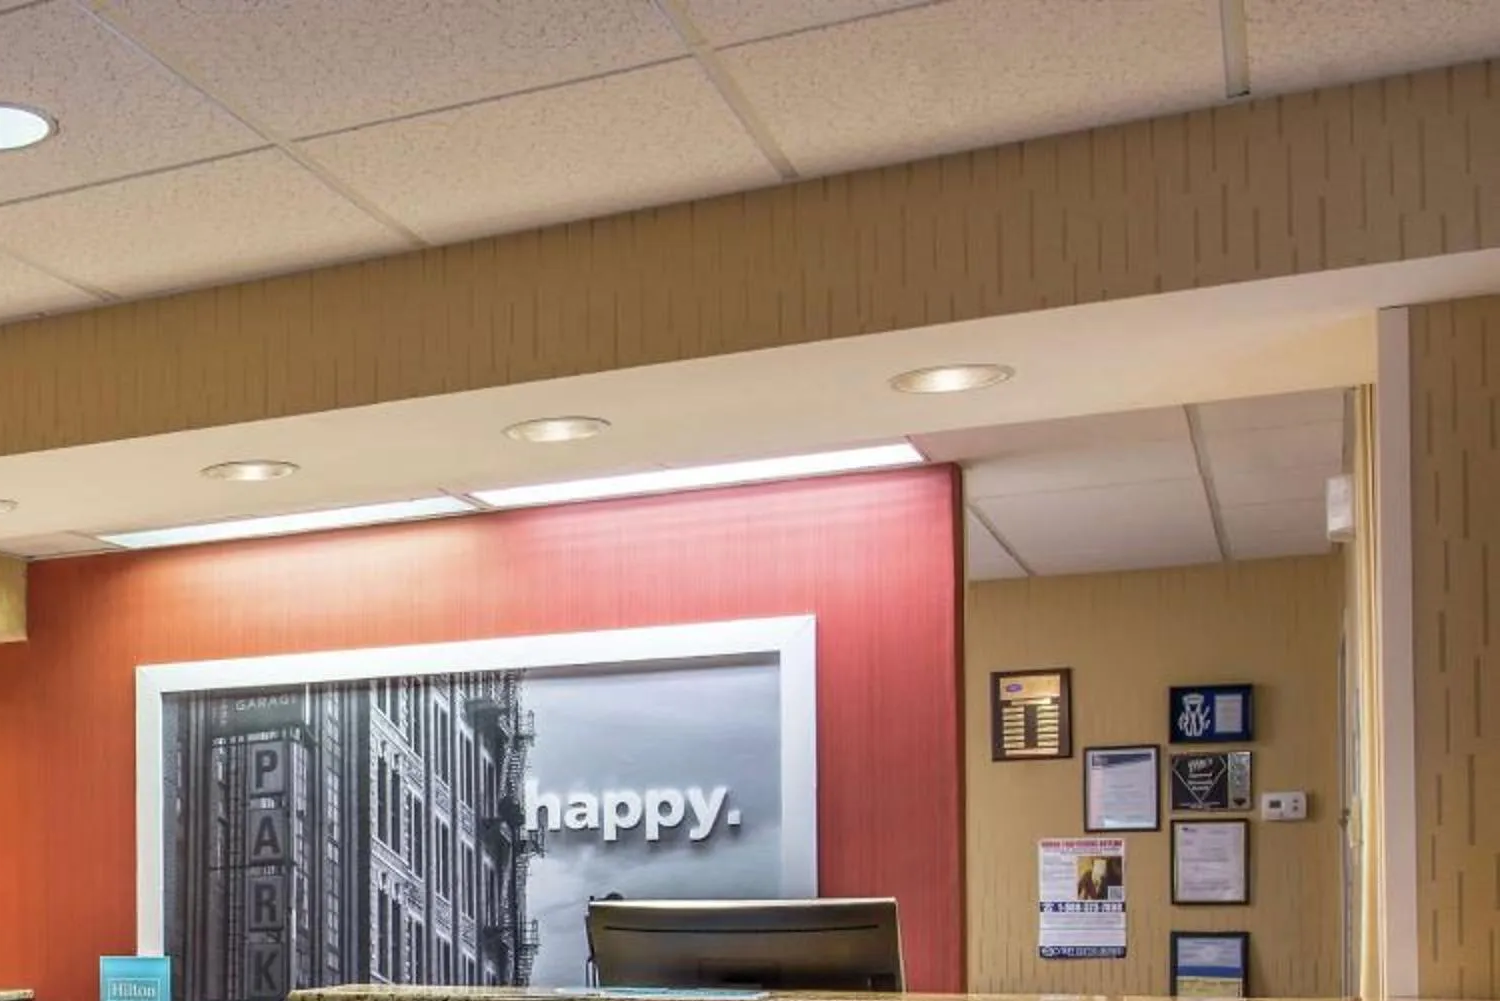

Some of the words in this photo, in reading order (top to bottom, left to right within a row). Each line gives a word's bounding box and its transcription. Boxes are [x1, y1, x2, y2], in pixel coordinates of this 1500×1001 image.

[523, 778, 741, 841] happy.
[253, 749, 281, 992] PARK
[111, 982, 156, 997] Hilton
